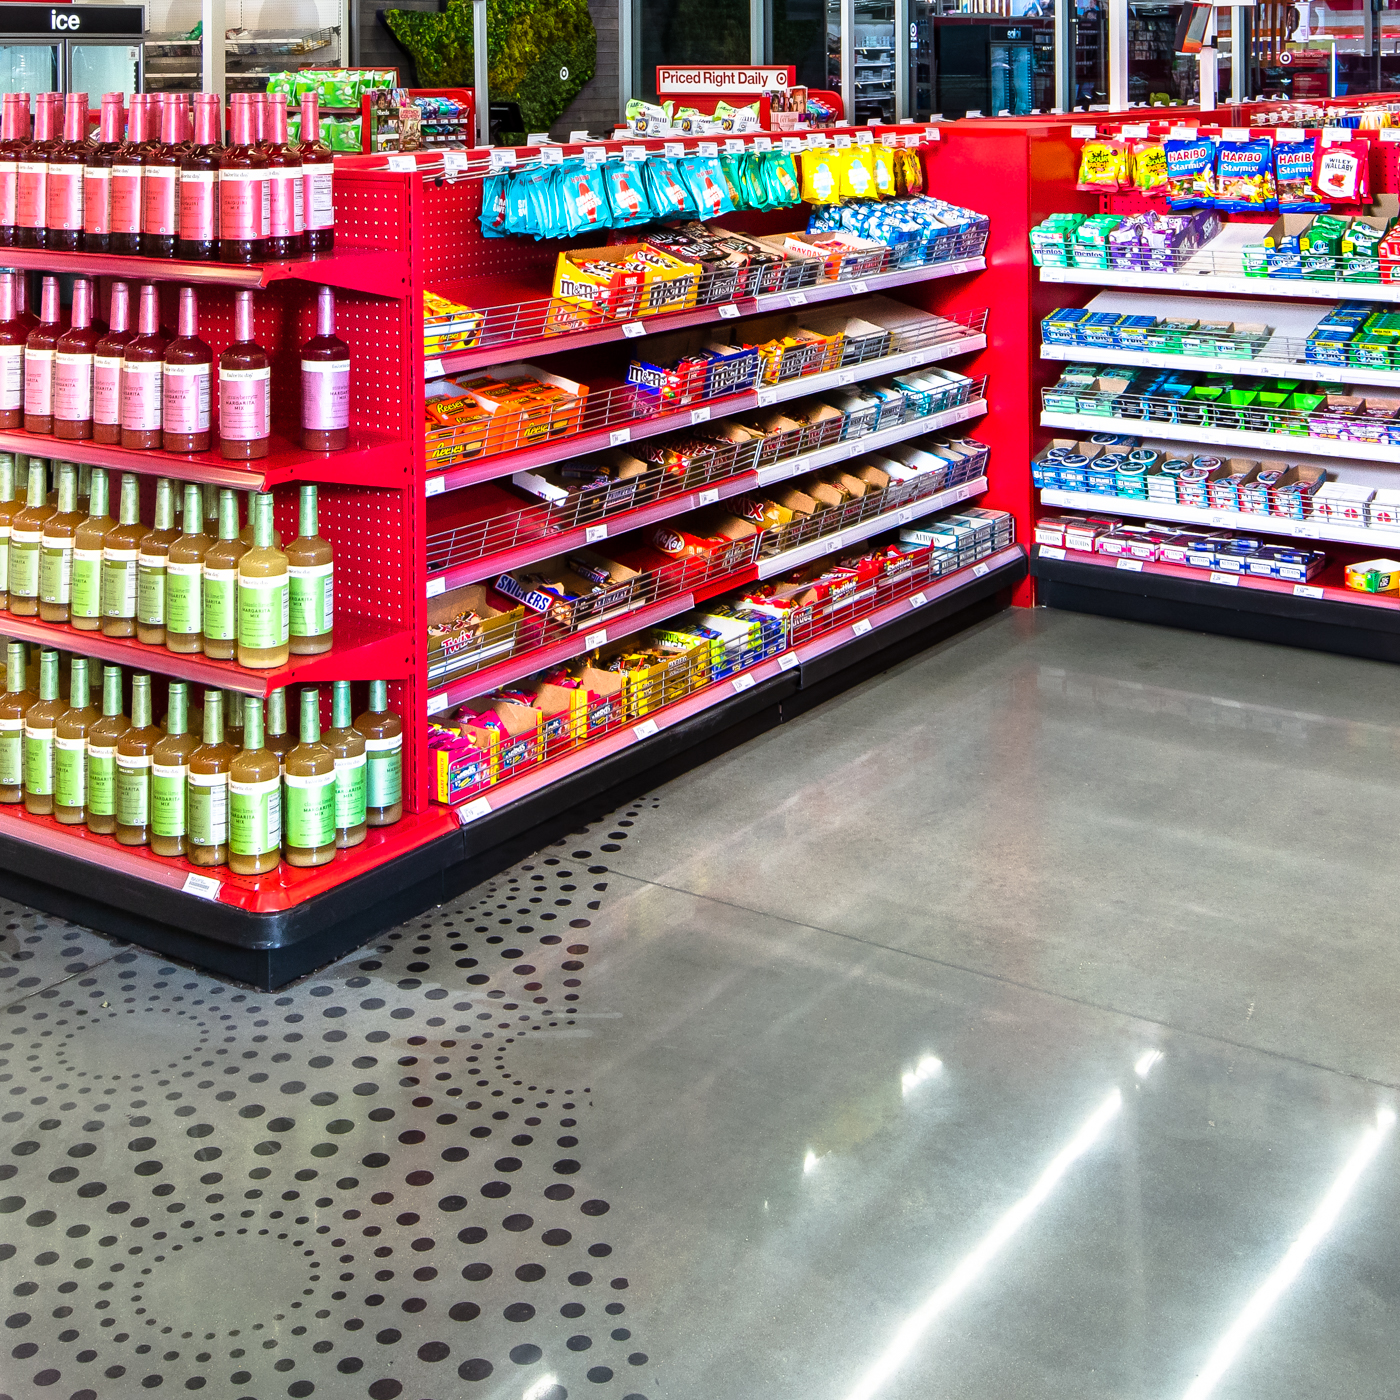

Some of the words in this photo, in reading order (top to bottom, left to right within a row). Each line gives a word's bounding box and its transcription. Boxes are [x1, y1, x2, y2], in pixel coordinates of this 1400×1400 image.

[51, 9, 80, 31] ice
[662, 71, 701, 84] Priced
[703, 71, 735, 88] Right
[737, 72, 768, 88] Daily
[1168, 148, 1207, 162] HARIBO
[1221, 152, 1262, 163] HARIBO
[1170, 162, 1206, 172] Starmix
[1221, 165, 1259, 174] Starmix
[1324, 162, 1354, 172] WALLABY
[498, 574, 552, 611] SNICKERS
